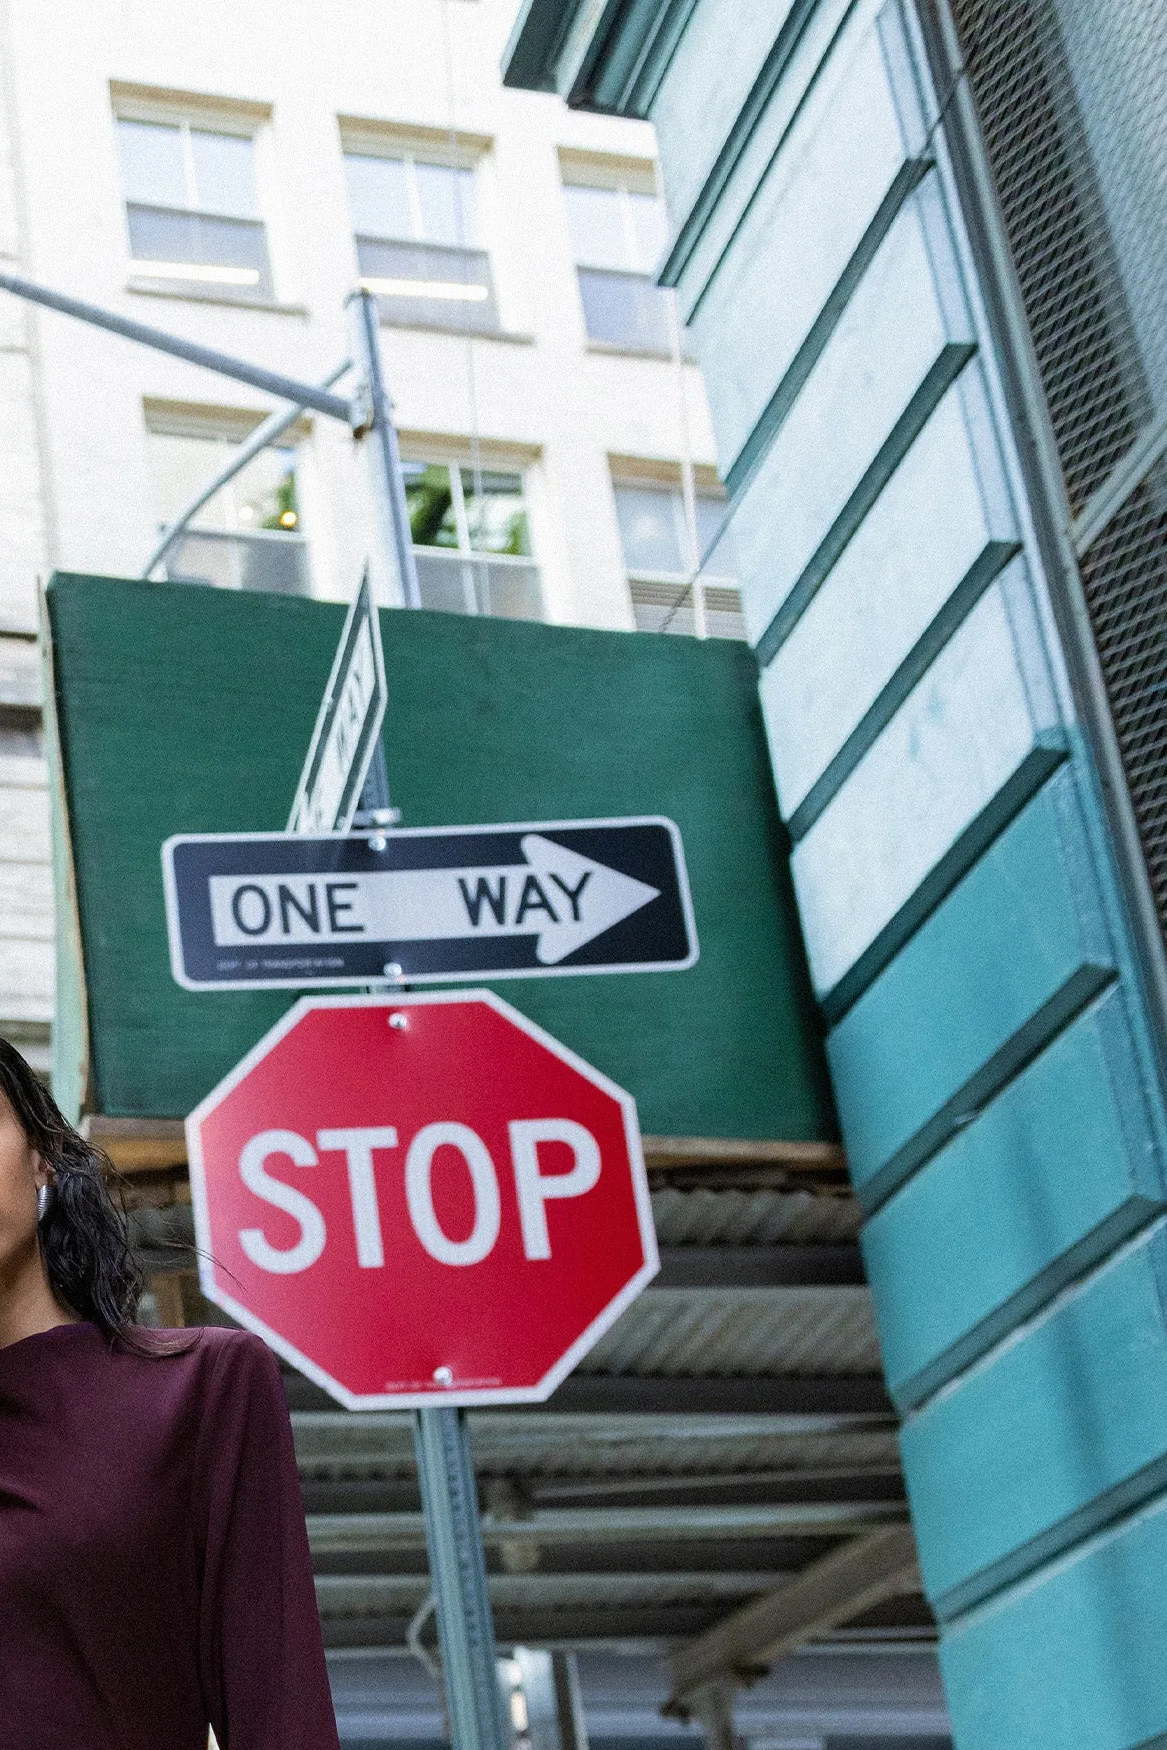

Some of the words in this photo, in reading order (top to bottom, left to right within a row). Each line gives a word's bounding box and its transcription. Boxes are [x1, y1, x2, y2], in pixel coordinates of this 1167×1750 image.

[231, 883, 365, 935] ONE
[458, 872, 592, 927] WAY
[238, 1118, 603, 1275] STOP
